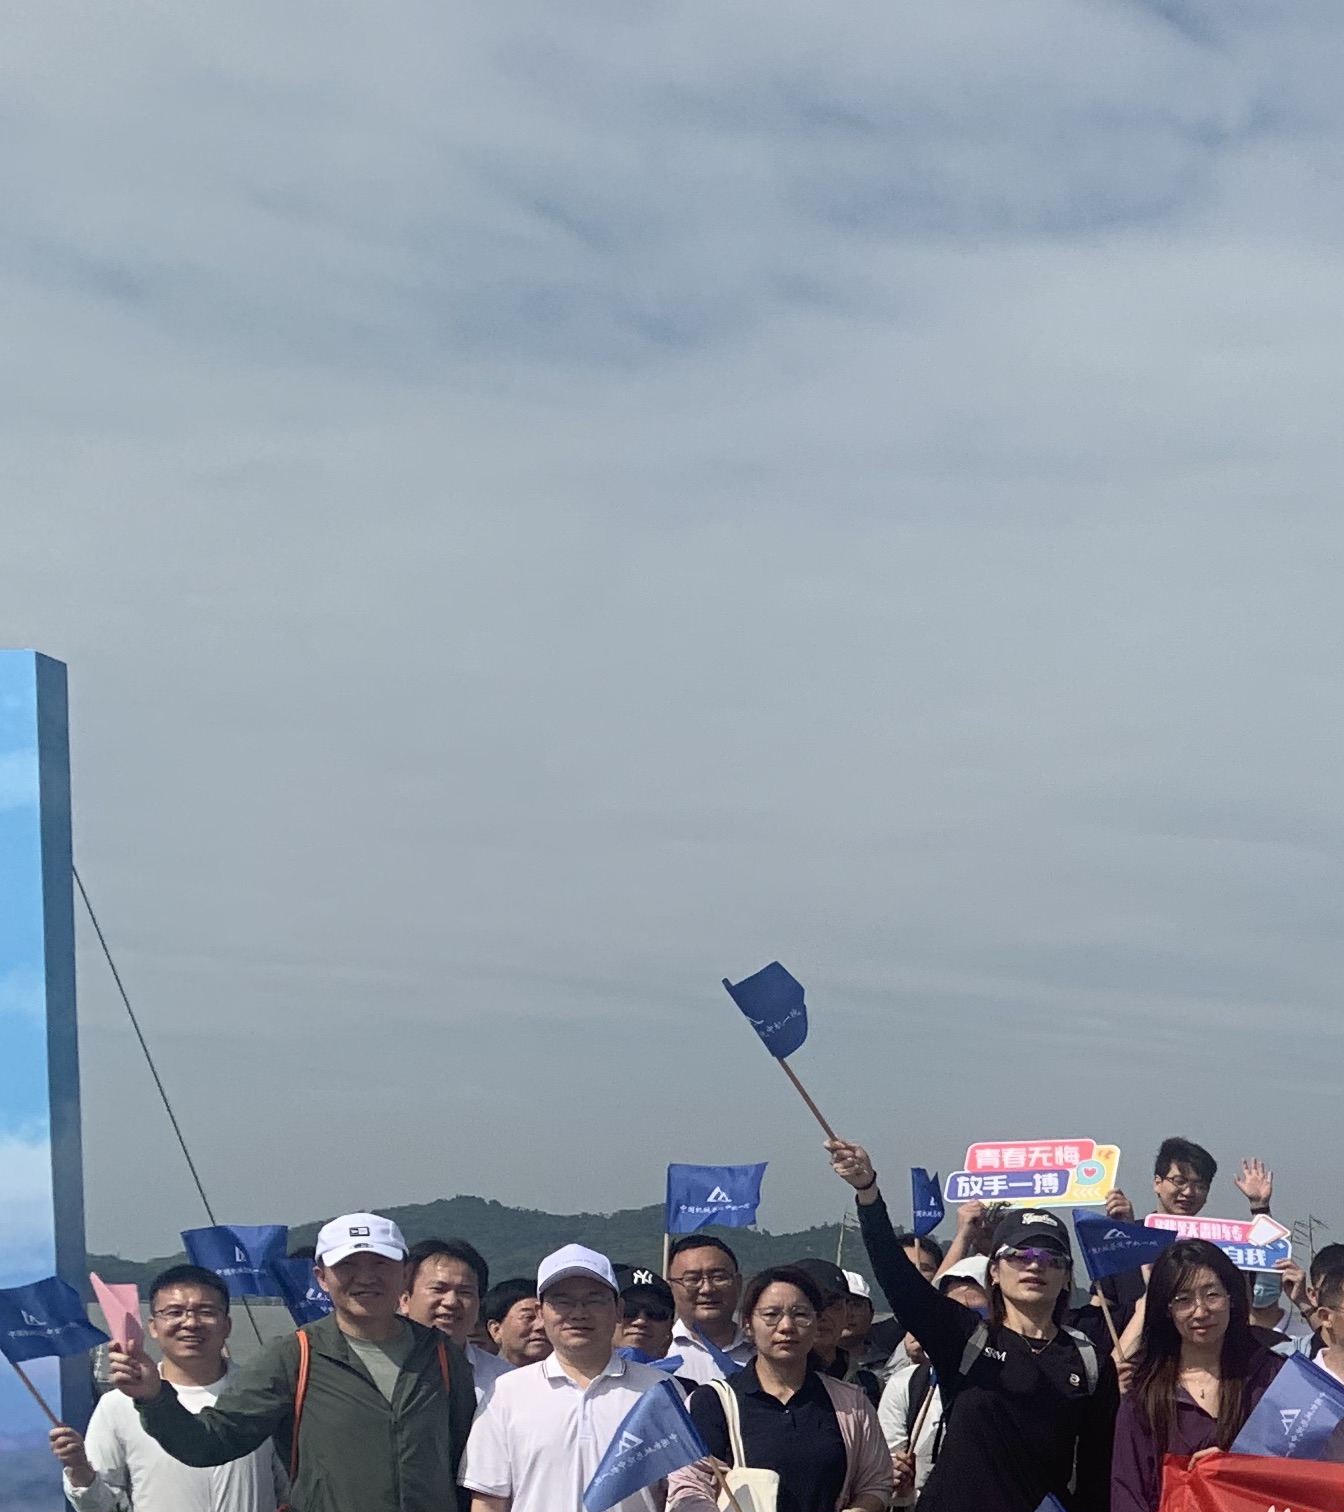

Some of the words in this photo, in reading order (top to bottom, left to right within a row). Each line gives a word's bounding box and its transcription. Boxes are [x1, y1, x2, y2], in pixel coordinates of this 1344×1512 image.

[975, 1145, 1080, 1169] 青春无悔
[956, 1173, 1059, 1198] 放手一搏
[633, 1269, 653, 1285] NY
